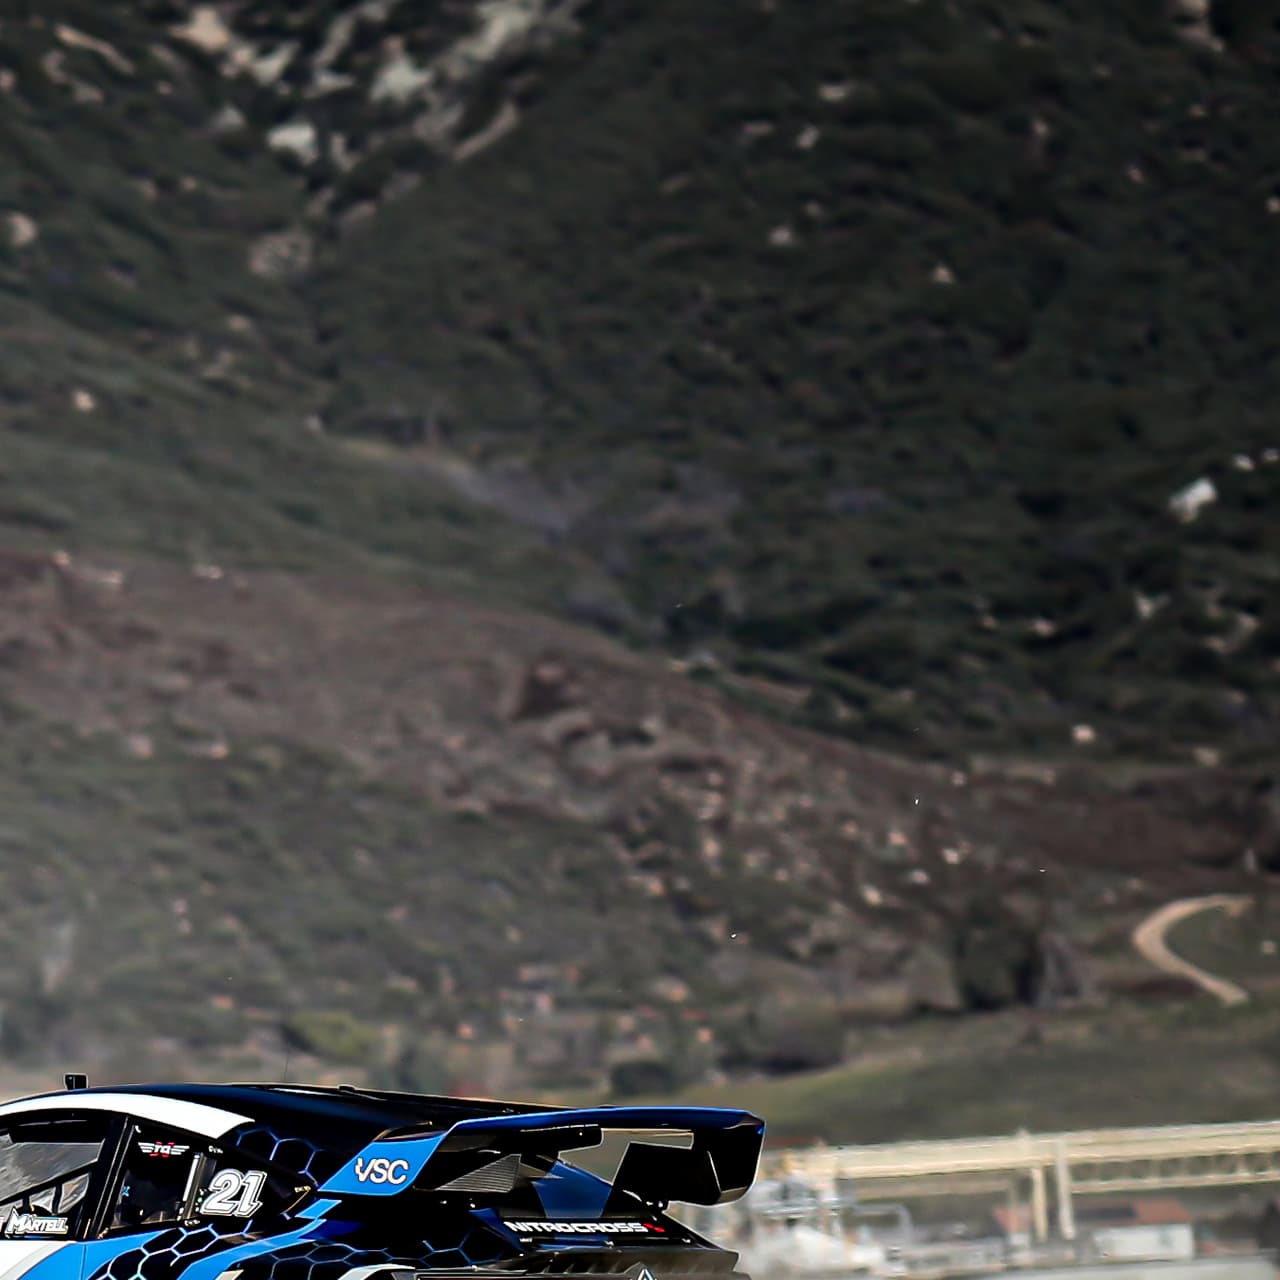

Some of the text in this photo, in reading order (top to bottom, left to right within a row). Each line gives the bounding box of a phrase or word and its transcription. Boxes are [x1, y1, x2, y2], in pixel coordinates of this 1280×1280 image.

[354, 1157, 409, 1185] VSC
[199, 1168, 268, 1218] 21
[4, 1207, 69, 1235] MARTELL
[503, 1221, 649, 1233] NITROCROSS
